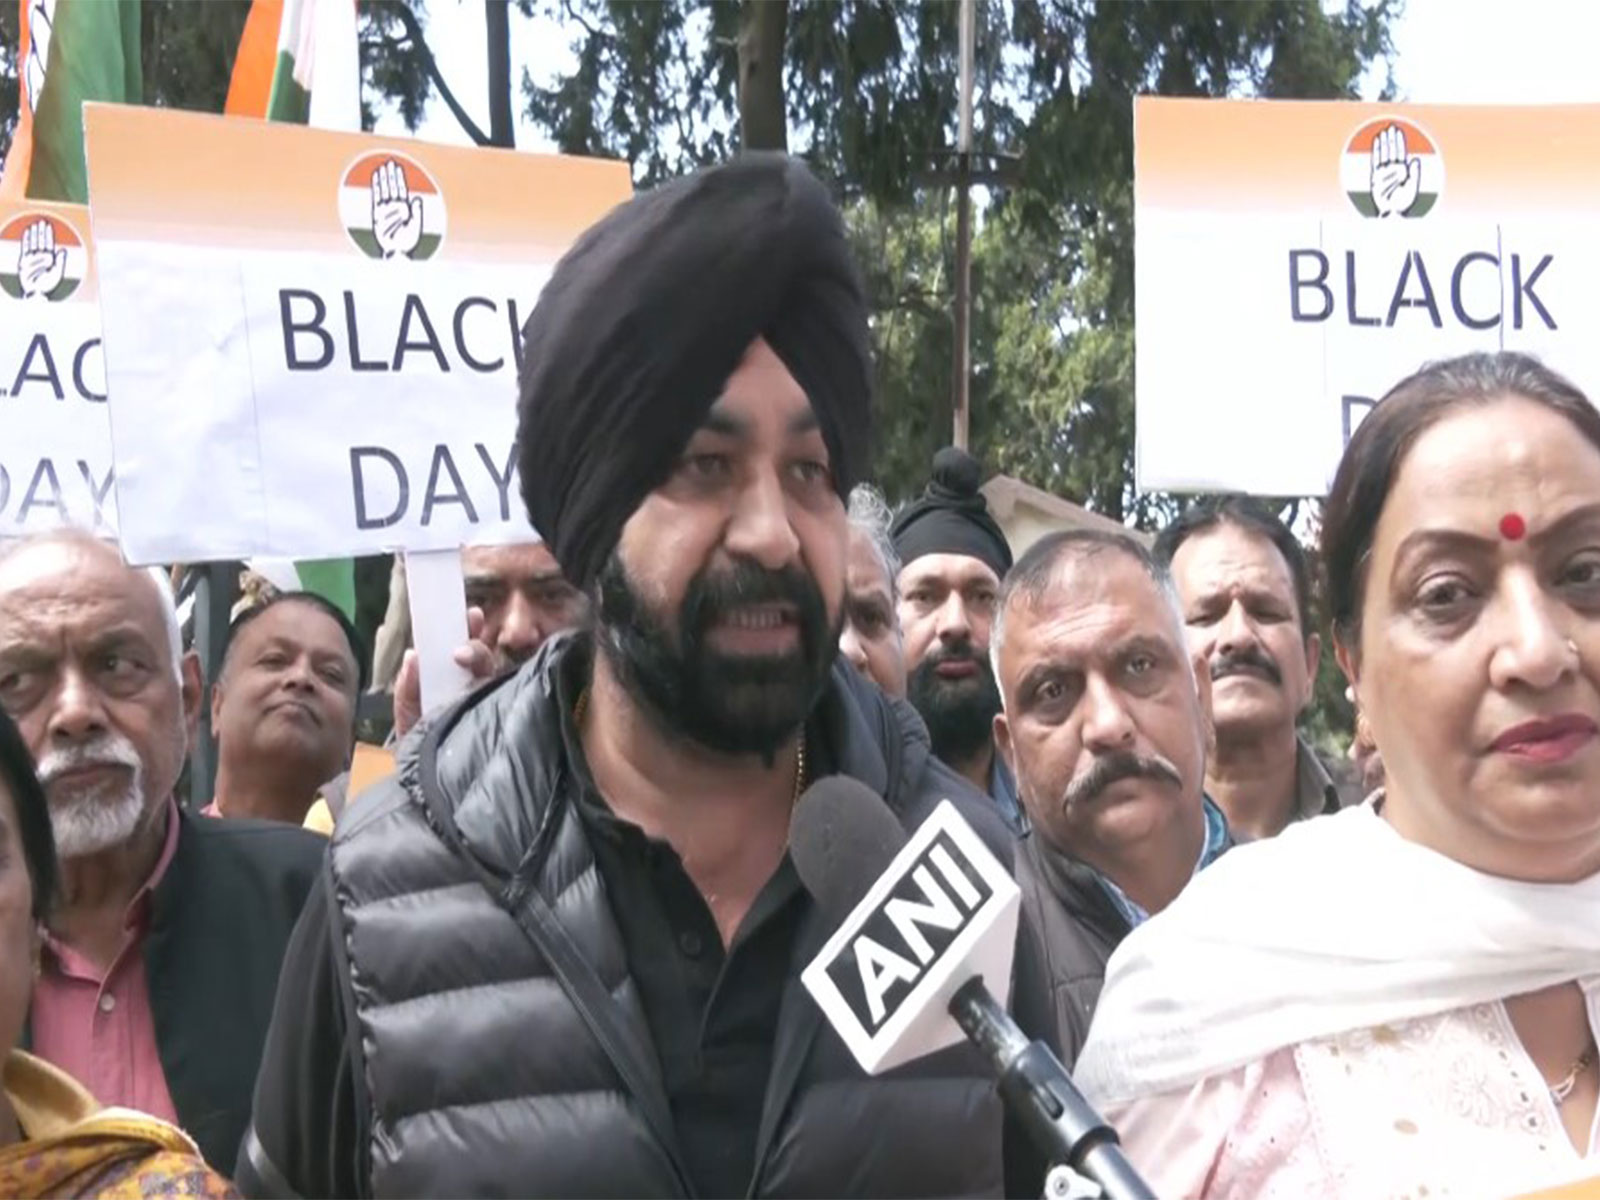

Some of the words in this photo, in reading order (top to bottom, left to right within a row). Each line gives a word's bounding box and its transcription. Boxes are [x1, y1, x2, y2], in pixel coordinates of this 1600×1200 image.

[1288, 248, 1559, 331] BLACK
[0, 332, 108, 403] AC
[349, 442, 518, 530] DAY
[853, 842, 983, 1026] ANI
